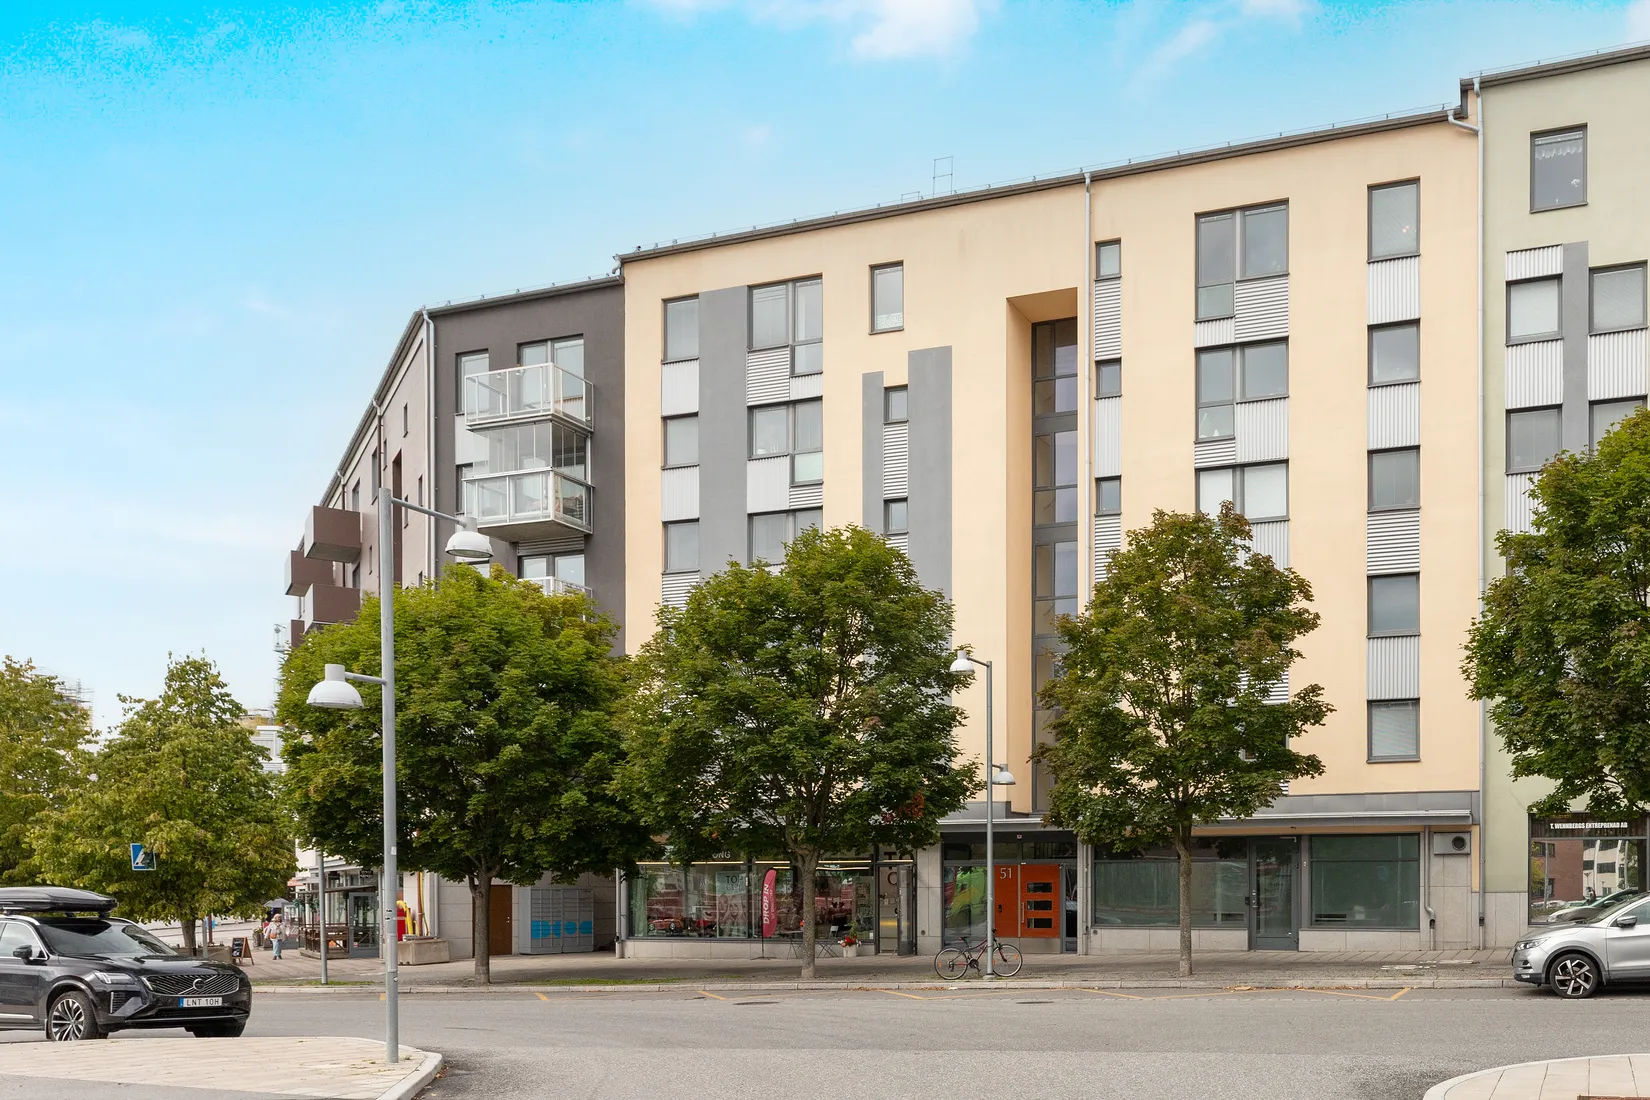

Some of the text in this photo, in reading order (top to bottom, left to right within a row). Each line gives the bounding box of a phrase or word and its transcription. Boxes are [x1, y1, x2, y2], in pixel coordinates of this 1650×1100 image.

[1000, 868, 1011, 879] 51
[725, 875, 744, 884] TOP
[763, 883, 770, 895] IN
